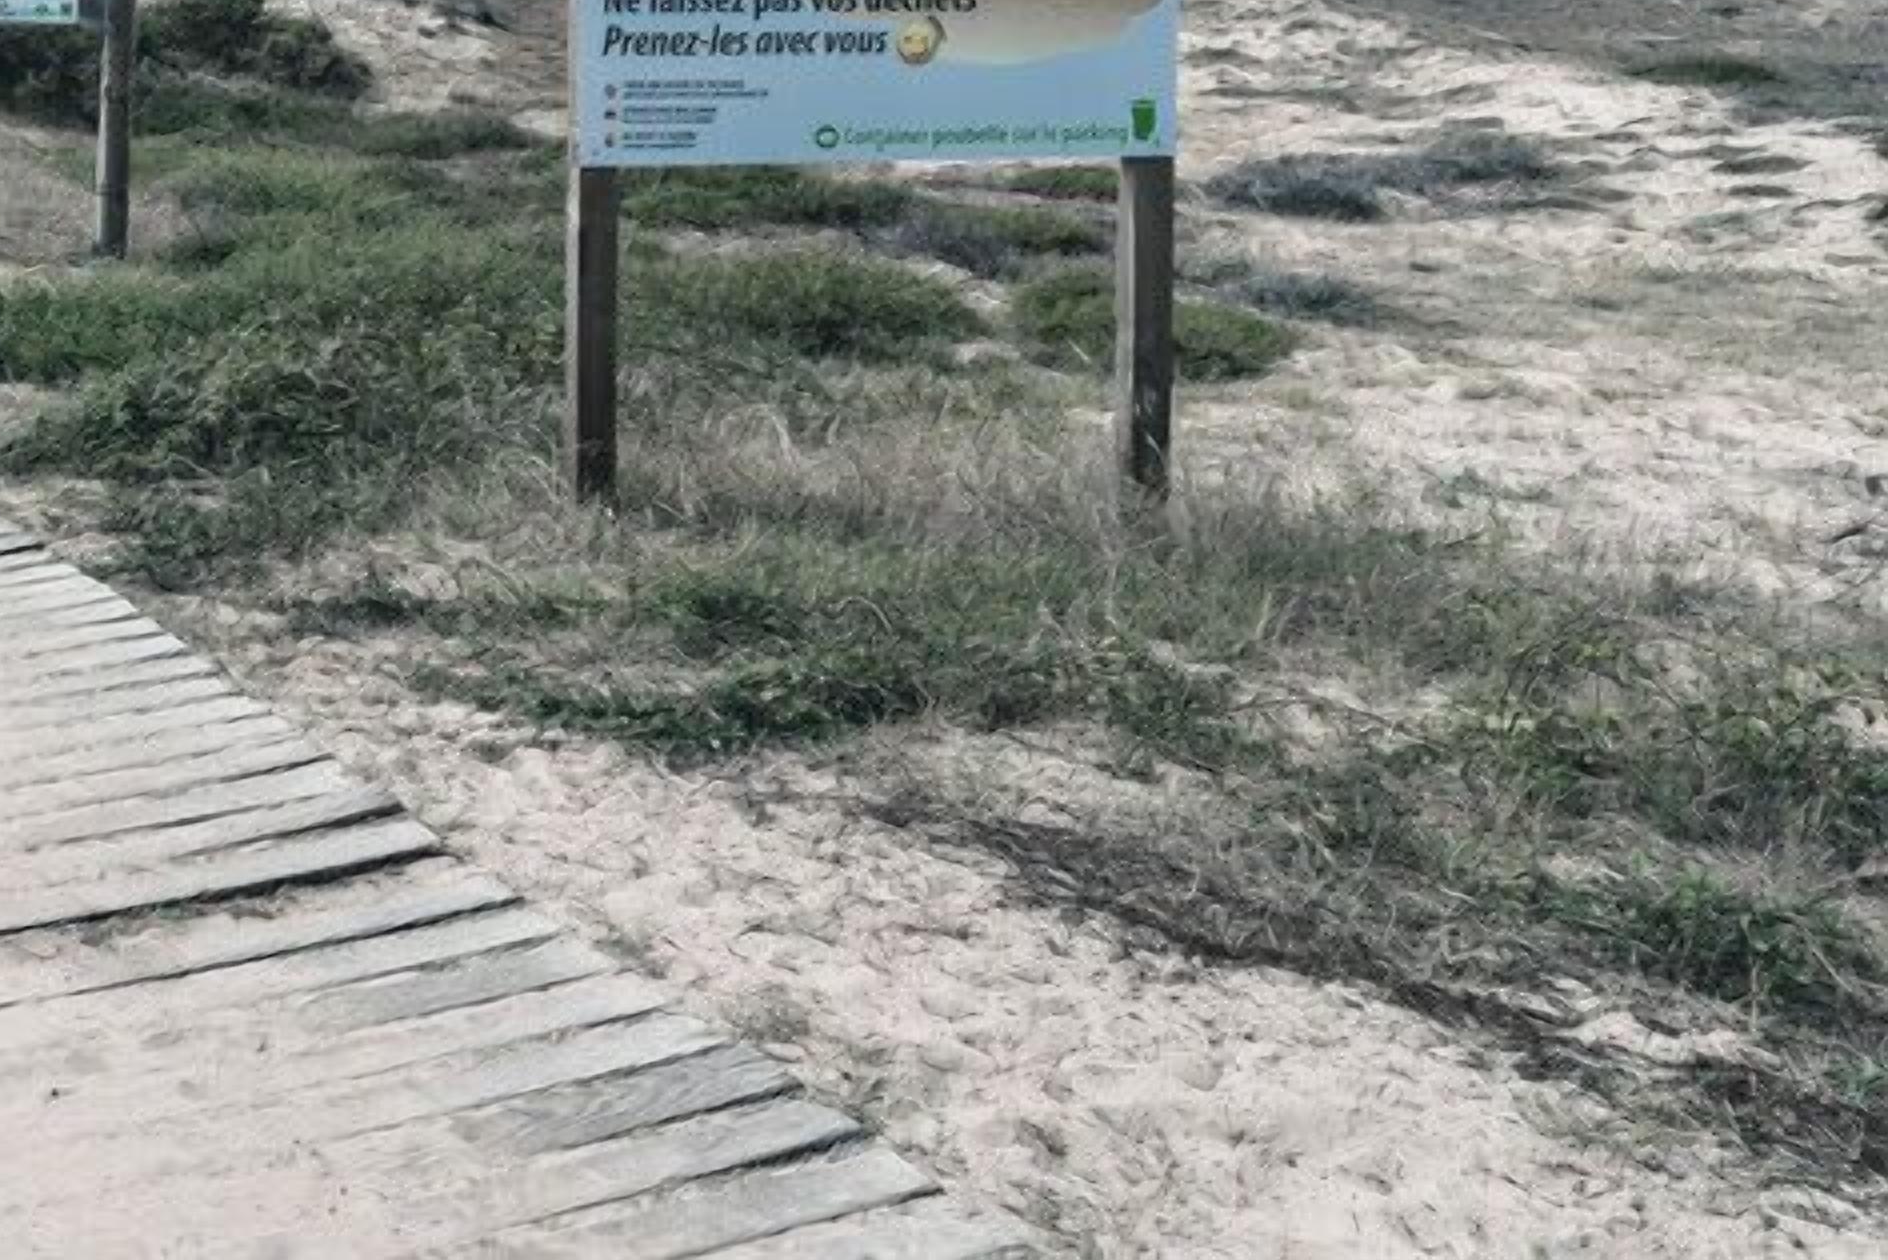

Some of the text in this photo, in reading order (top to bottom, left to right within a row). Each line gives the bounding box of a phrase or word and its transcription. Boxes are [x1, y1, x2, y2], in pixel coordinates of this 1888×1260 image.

[601, 25, 889, 57] Prenez-les avec vous
